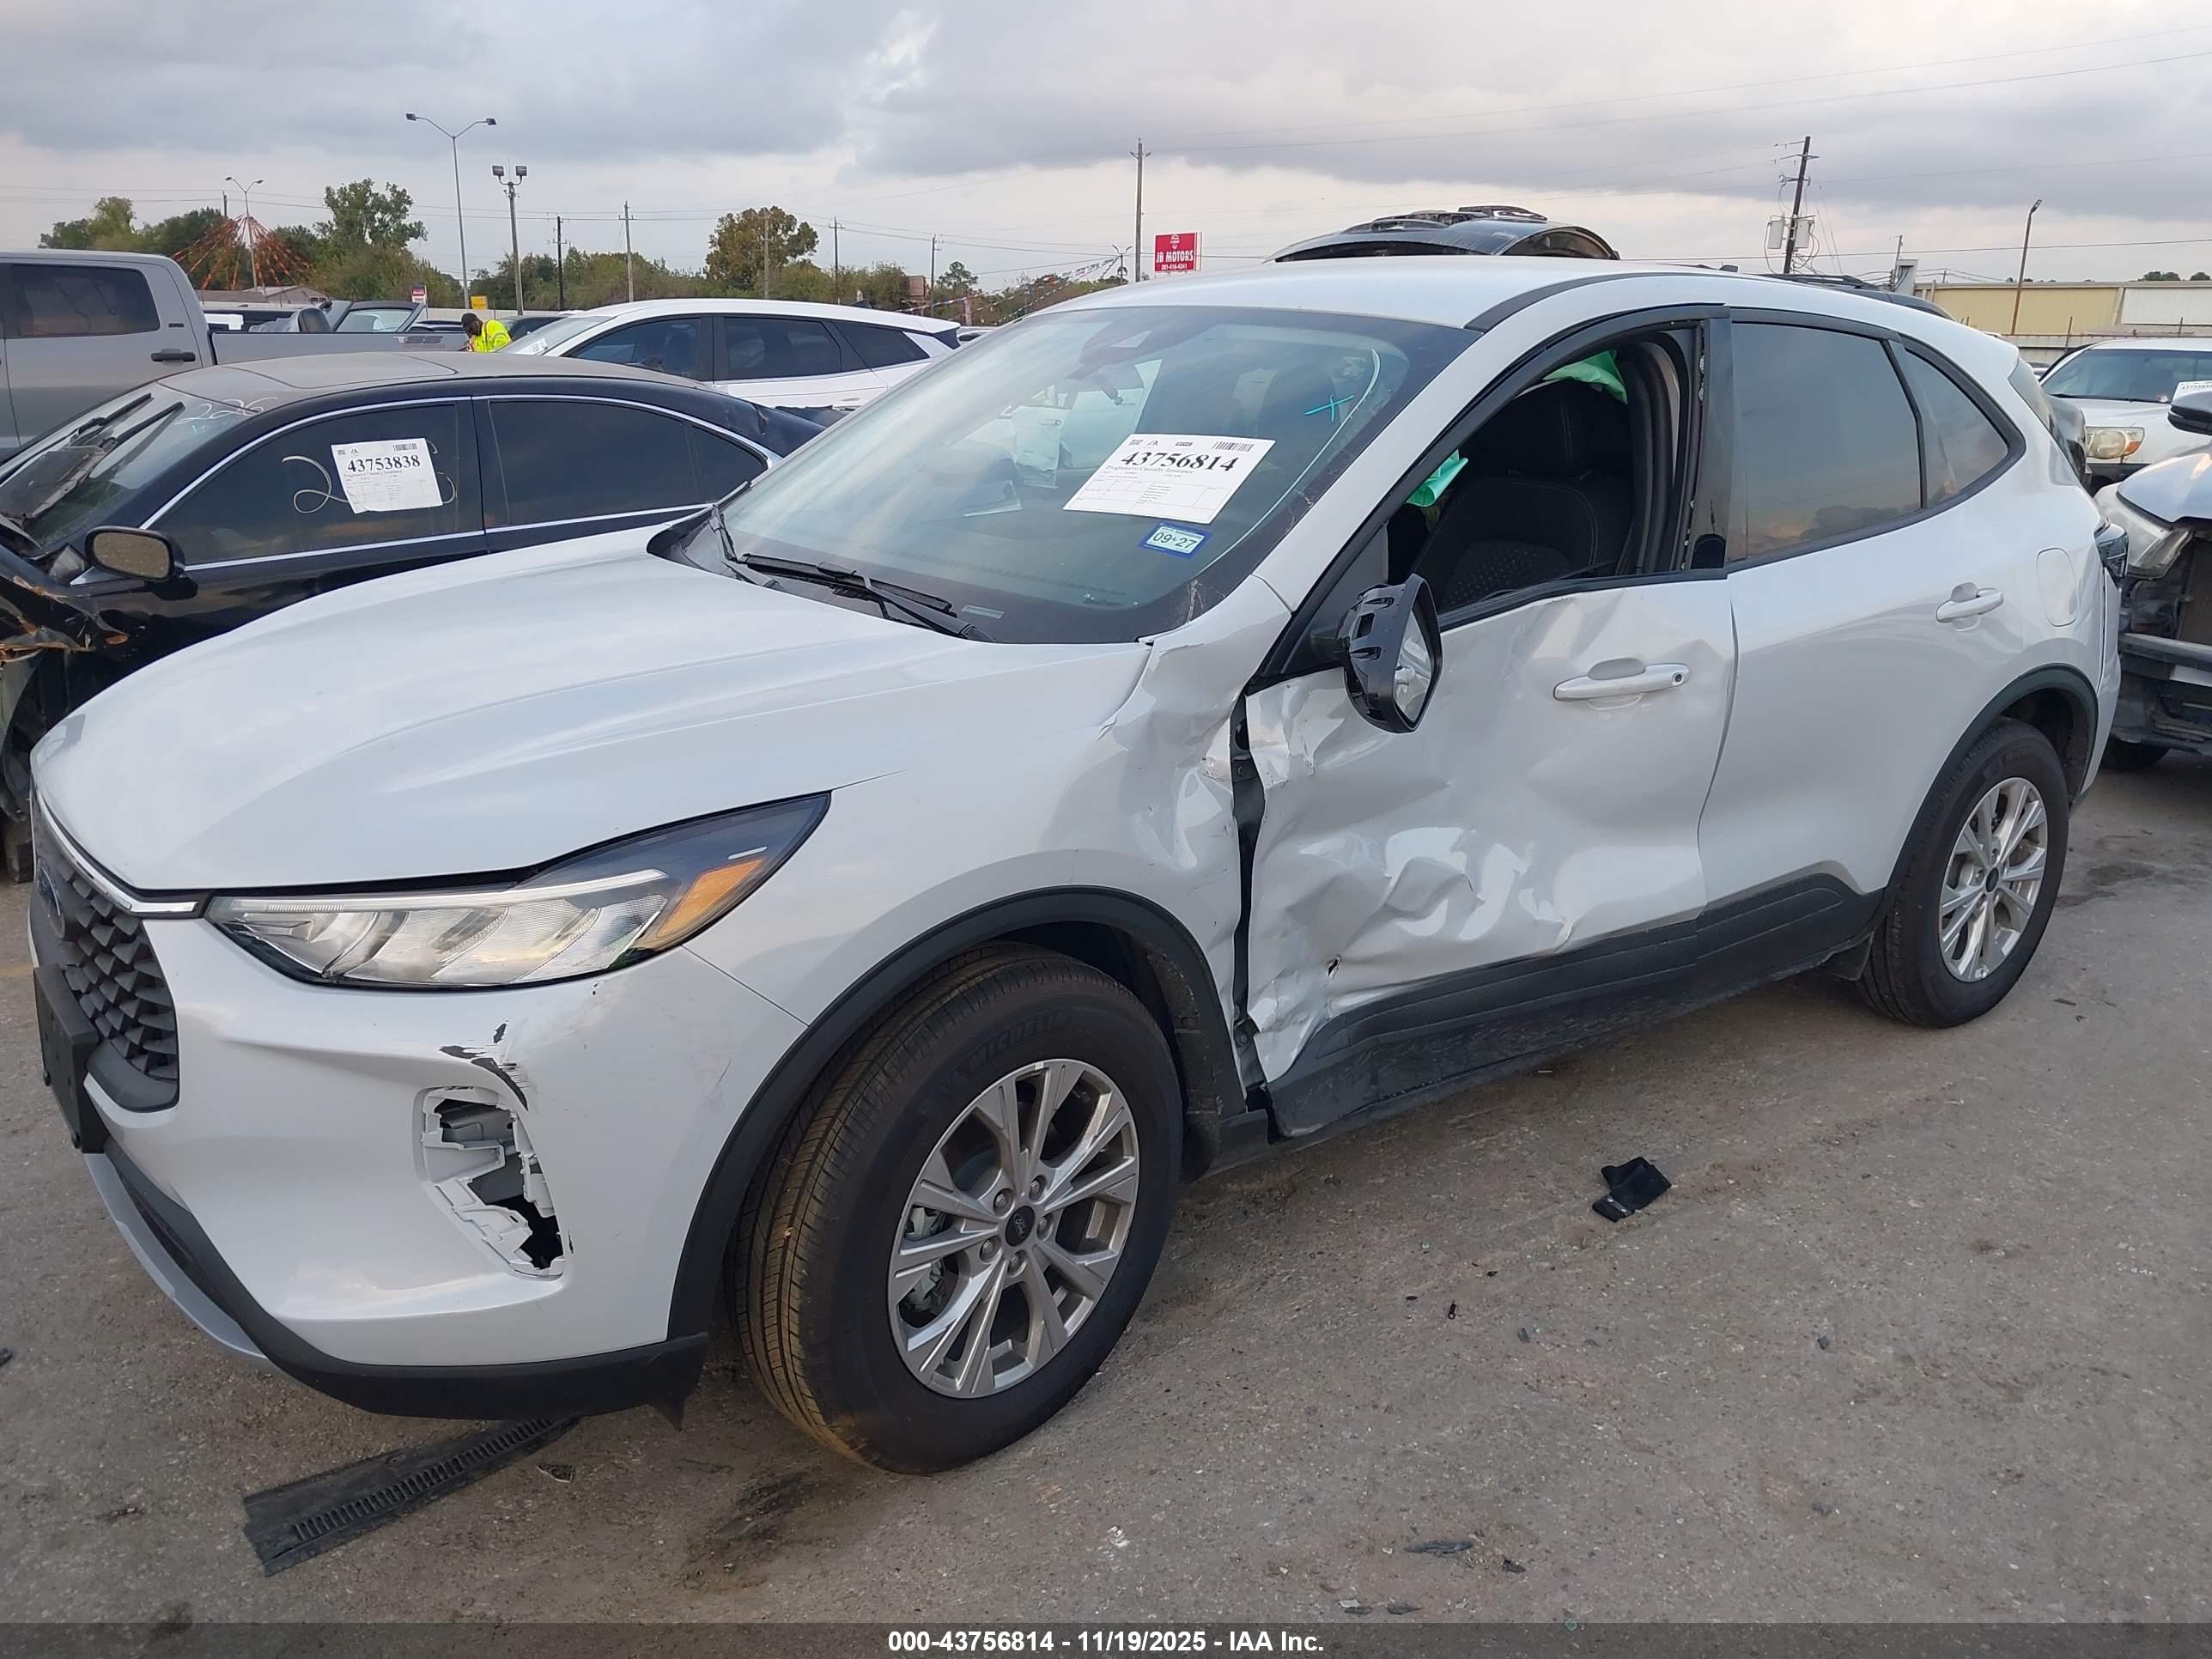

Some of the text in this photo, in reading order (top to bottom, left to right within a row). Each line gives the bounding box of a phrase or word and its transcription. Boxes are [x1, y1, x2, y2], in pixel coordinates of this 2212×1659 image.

[1156, 249, 1194, 263] JB MOTORS
[347, 454, 421, 472] 43753838
[1120, 451, 1239, 471] 43756814
